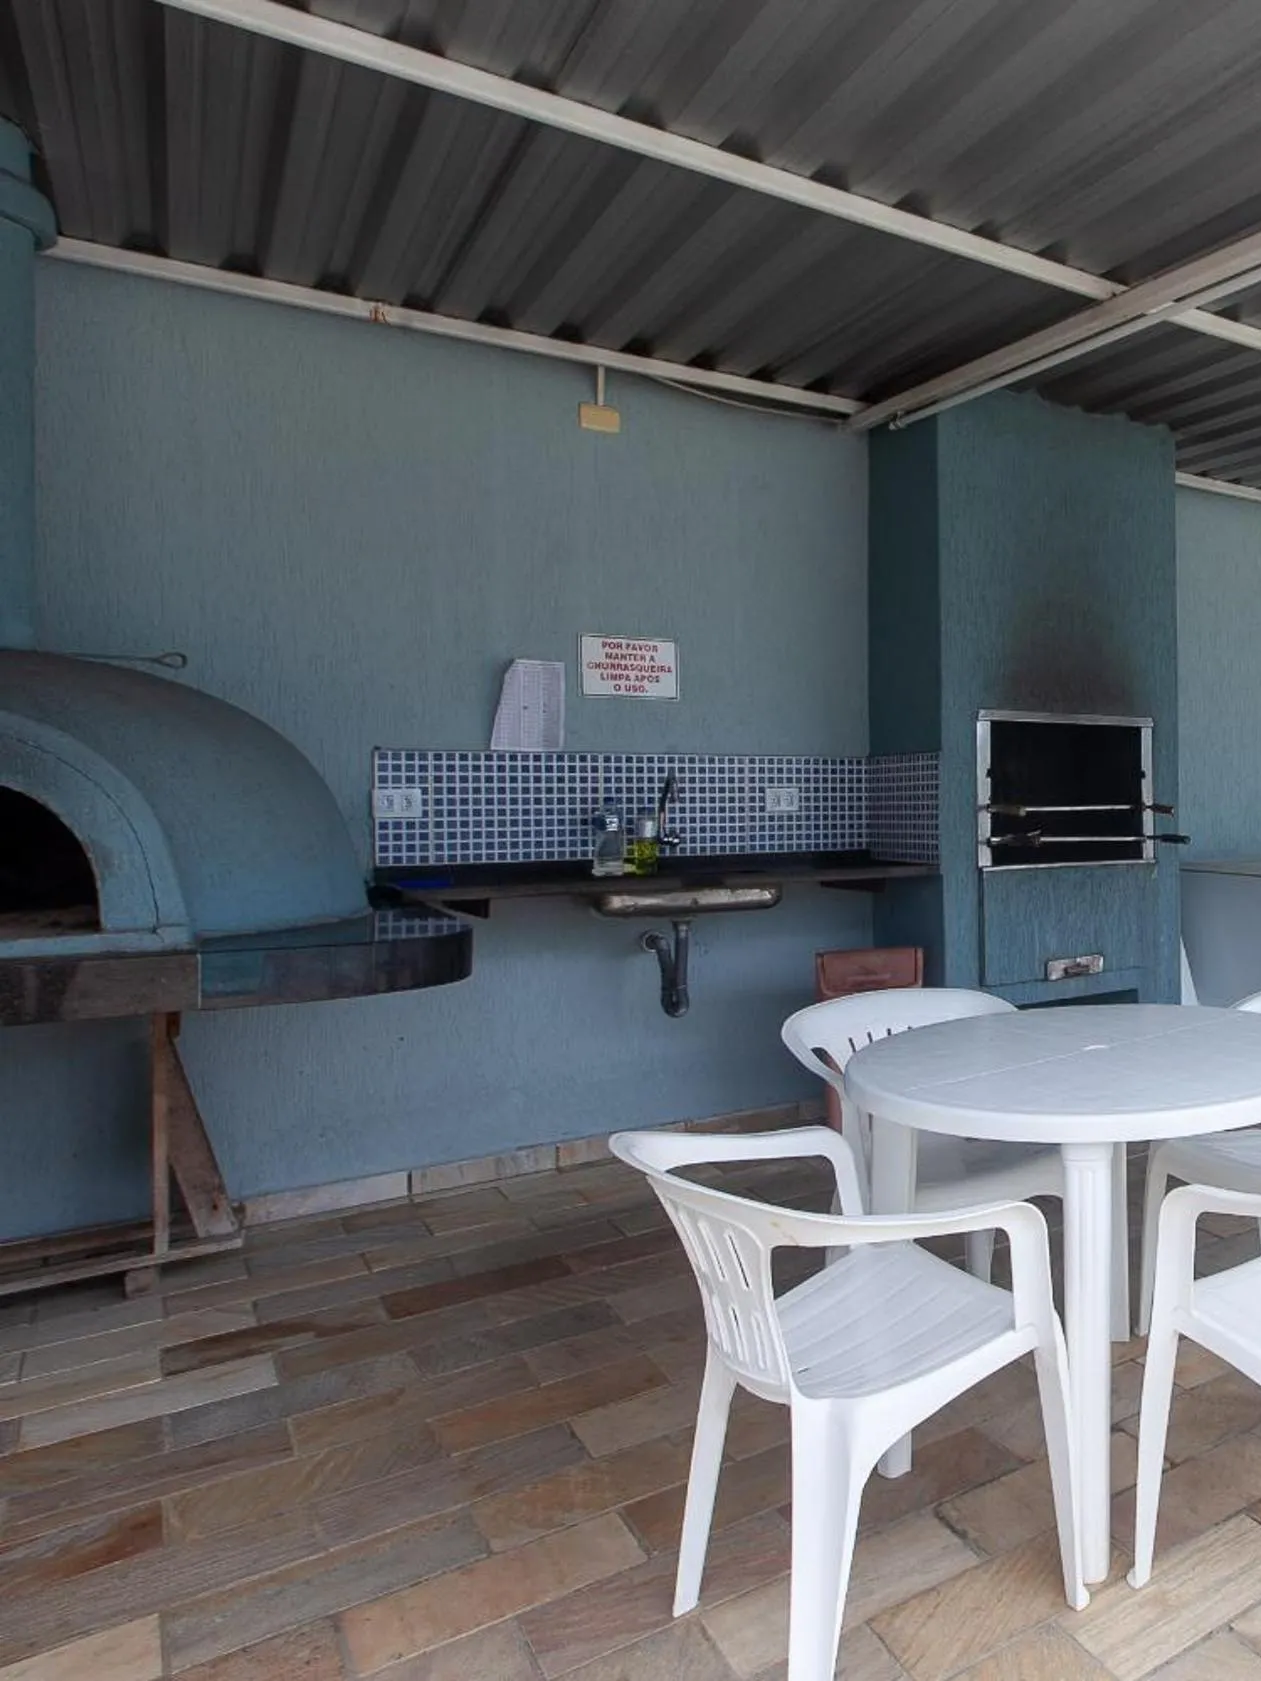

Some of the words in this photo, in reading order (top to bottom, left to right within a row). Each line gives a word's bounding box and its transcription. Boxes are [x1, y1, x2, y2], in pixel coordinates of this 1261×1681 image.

[604, 652, 646, 662] MANTER
[649, 655, 656, 663] A
[600, 672, 631, 681] LIMPA
[613, 684, 621, 692] O
